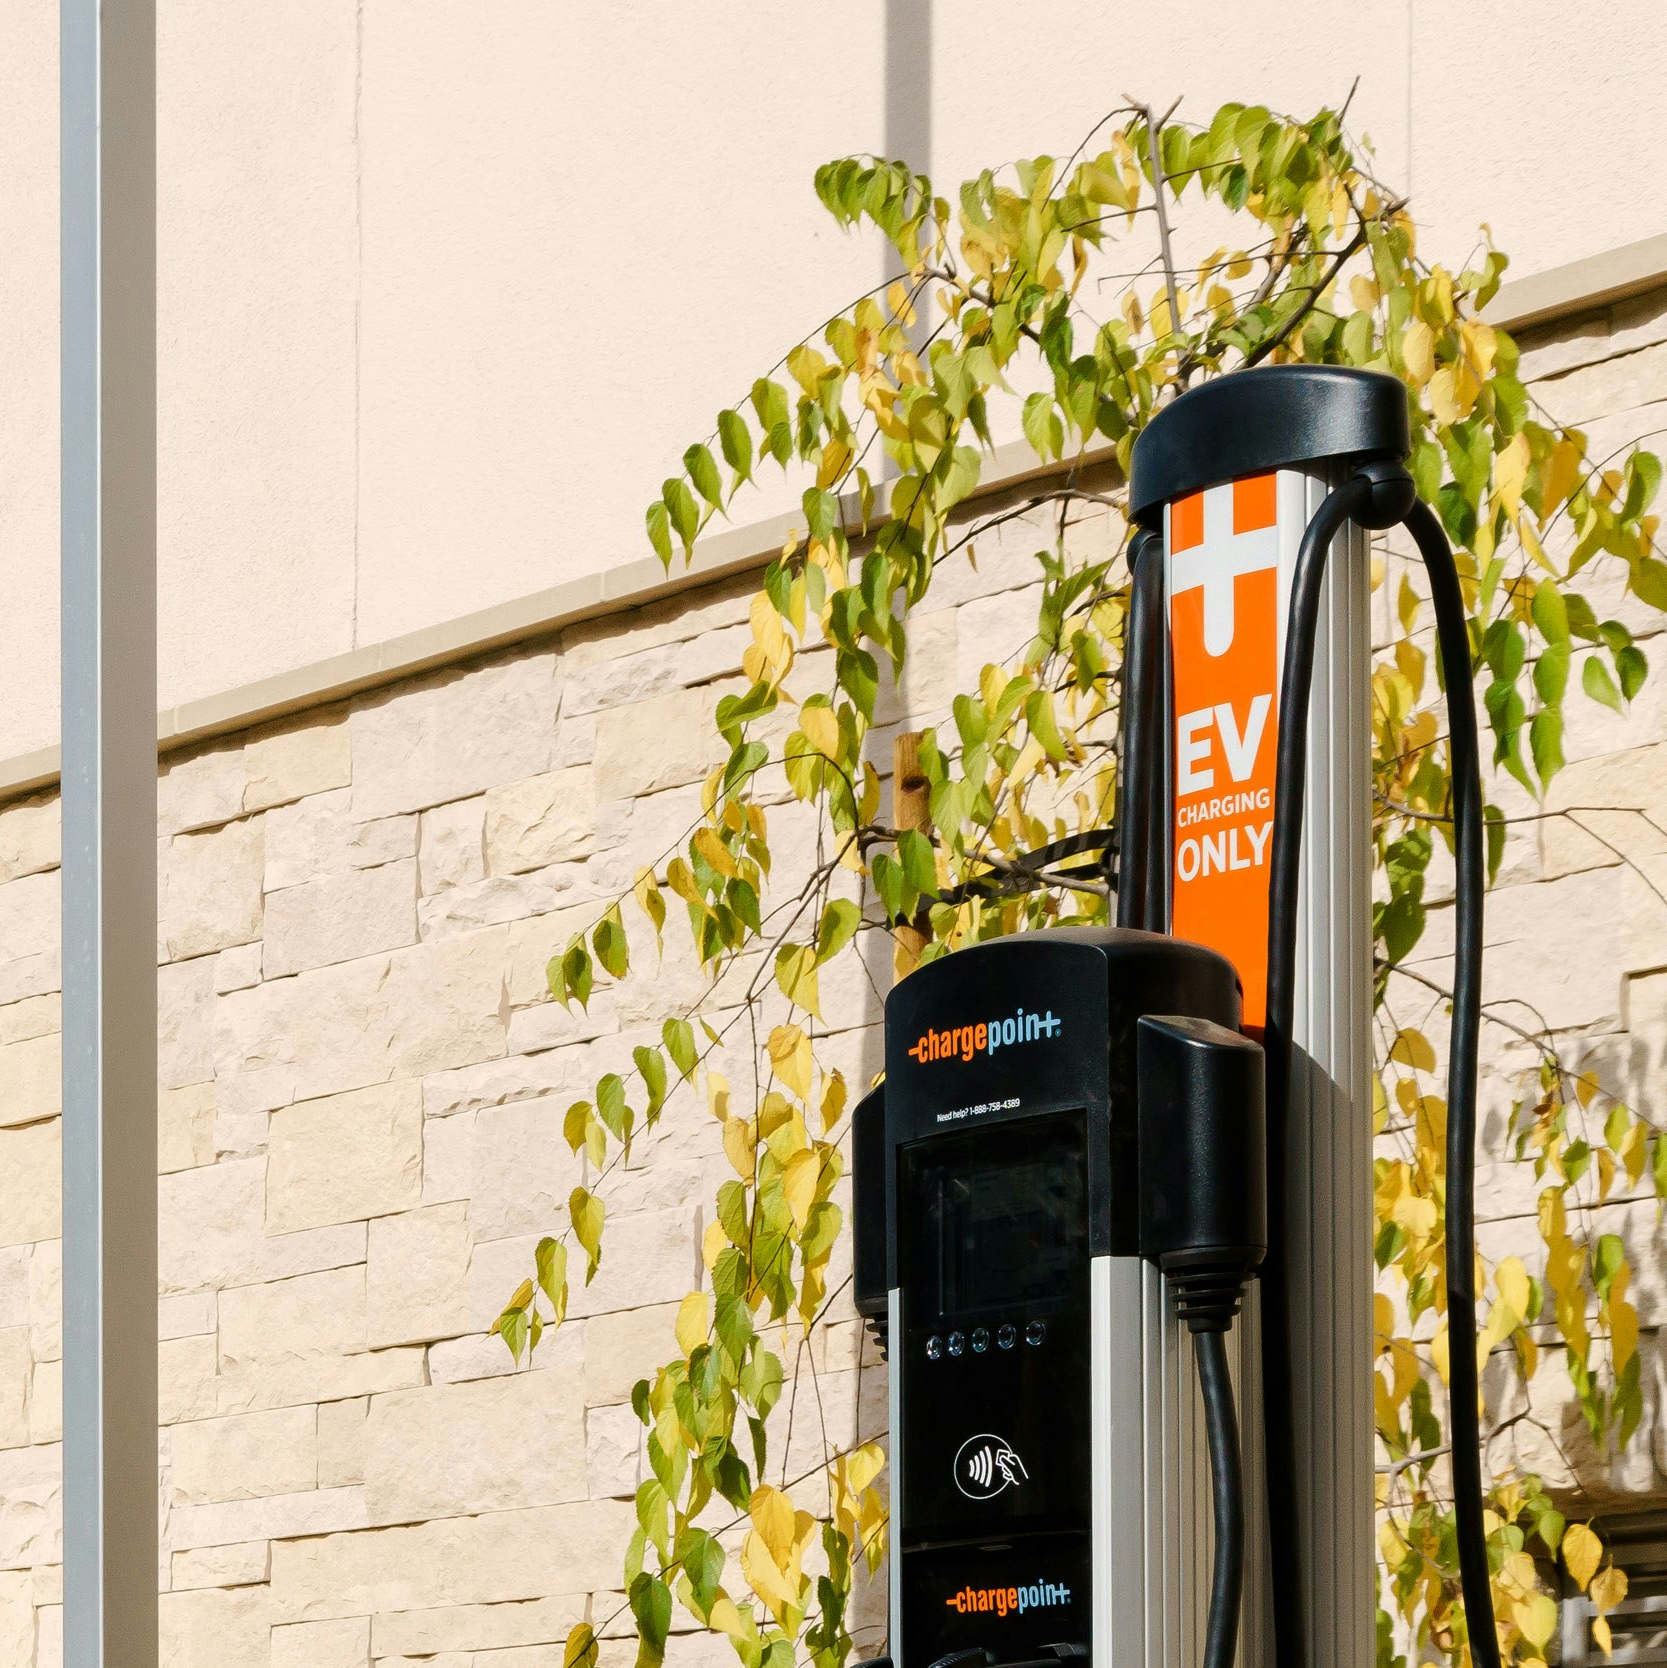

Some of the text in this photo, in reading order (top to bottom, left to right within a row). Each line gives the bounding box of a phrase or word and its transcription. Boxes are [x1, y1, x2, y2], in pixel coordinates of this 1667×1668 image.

[1177, 693, 1272, 797] EV
[1178, 788, 1270, 828] CHARGING
[1178, 821, 1273, 882] ONLY
[936, 1110, 952, 1122] Need
[952, 1107, 969, 1119] help?
